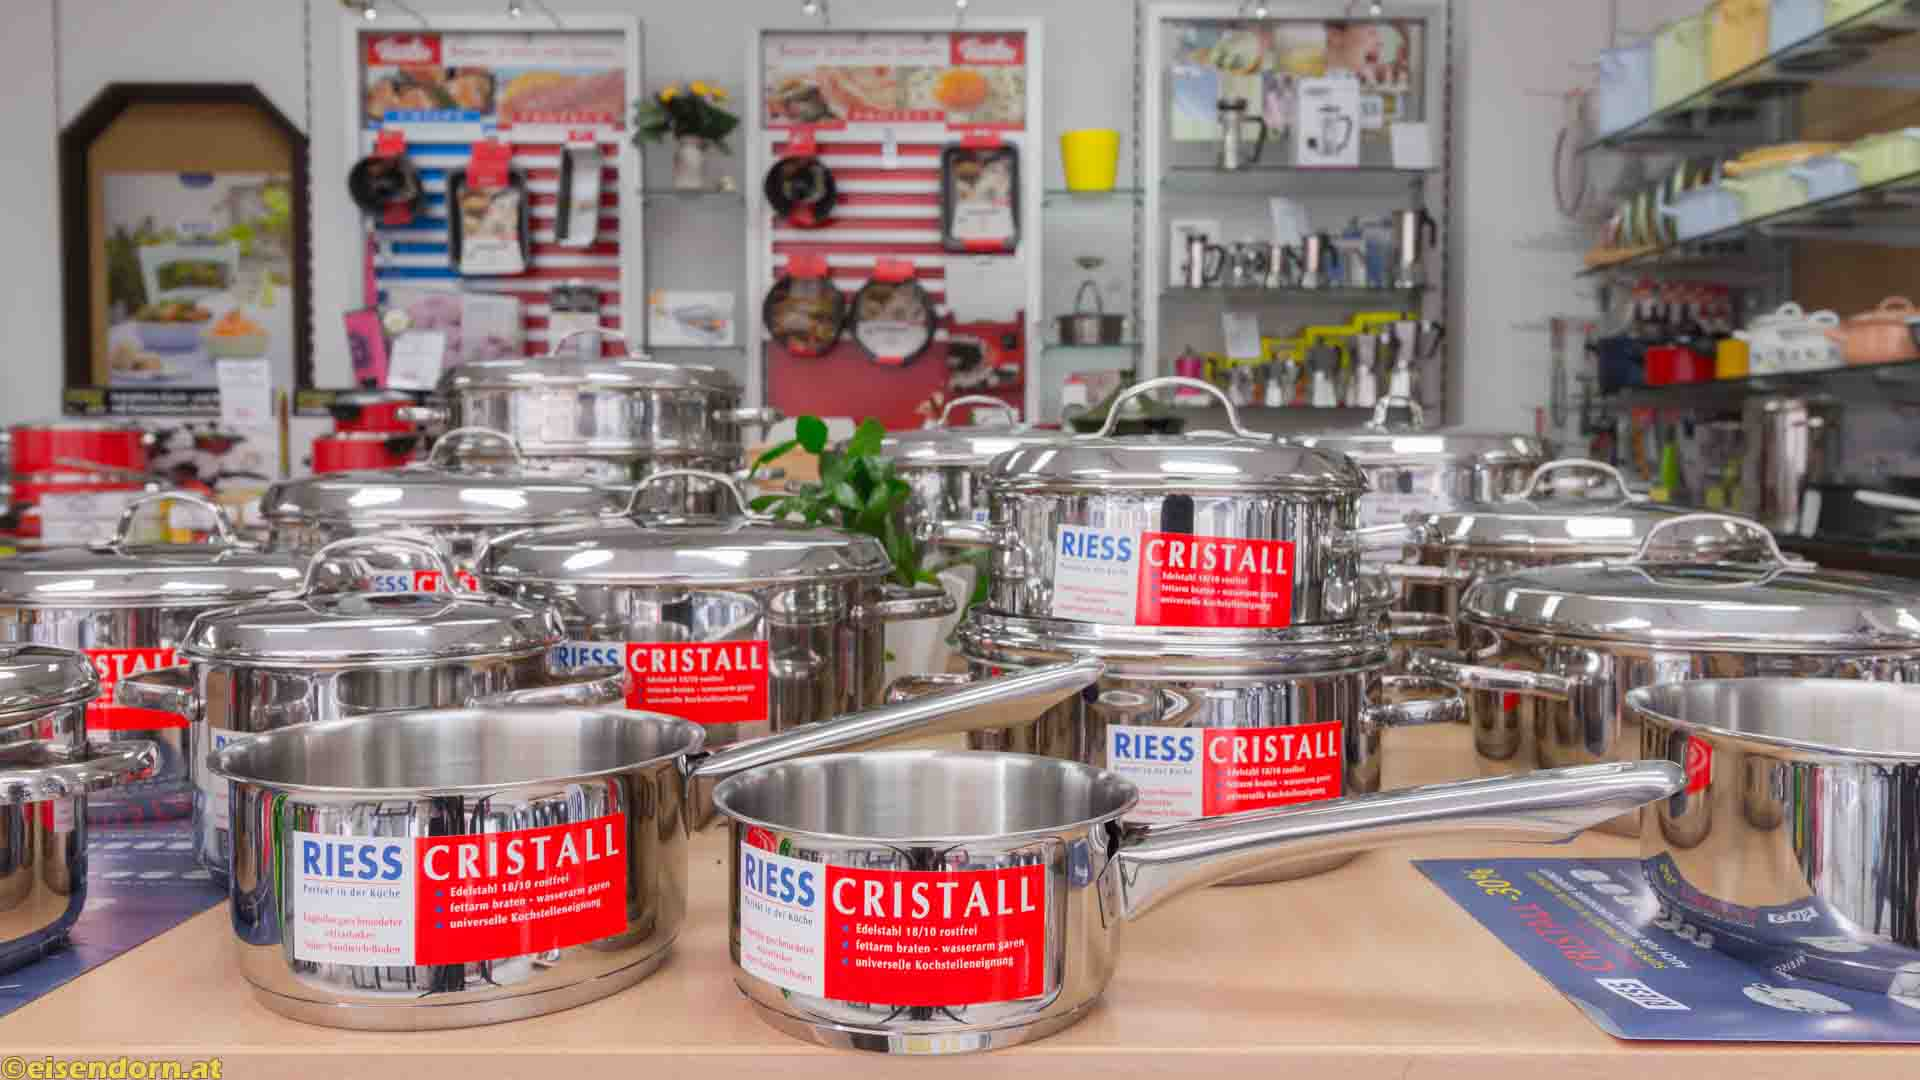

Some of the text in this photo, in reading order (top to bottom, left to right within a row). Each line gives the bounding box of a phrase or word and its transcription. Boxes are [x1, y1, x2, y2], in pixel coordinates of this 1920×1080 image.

[1061, 531, 1131, 562] RIESS
[1147, 540, 1287, 575] CRISTALL
[96, 653, 183, 679] STALL
[558, 645, 618, 667] RIESS
[631, 647, 763, 673] CRISTALL
[1114, 733, 1194, 762] RIESS
[1209, 730, 1337, 764] CRISTALL
[303, 840, 401, 881] RIESS
[424, 824, 619, 881] CRISTALL
[450, 874, 569, 898] Edelstahl 18/10 rostfrei
[744, 853, 815, 908] RIESS
[450, 899, 489, 914] fettarm
[492, 896, 526, 909] braten
[536, 886, 585, 904] wasserarm
[587, 880, 611, 896] garen
[832, 876, 1036, 919] CRISTALL
[450, 898, 601, 929] universelle Kochstelleneignung
[856, 923, 978, 939] Edelstahl 18/10 rostfrei
[856, 939, 893, 953] fettarm
[897, 941, 931, 953] braten
[942, 941, 996, 953] wasserarm
[998, 937, 1025, 951] garen
[855, 955, 1014, 971] universelle Kochstelleneignung
